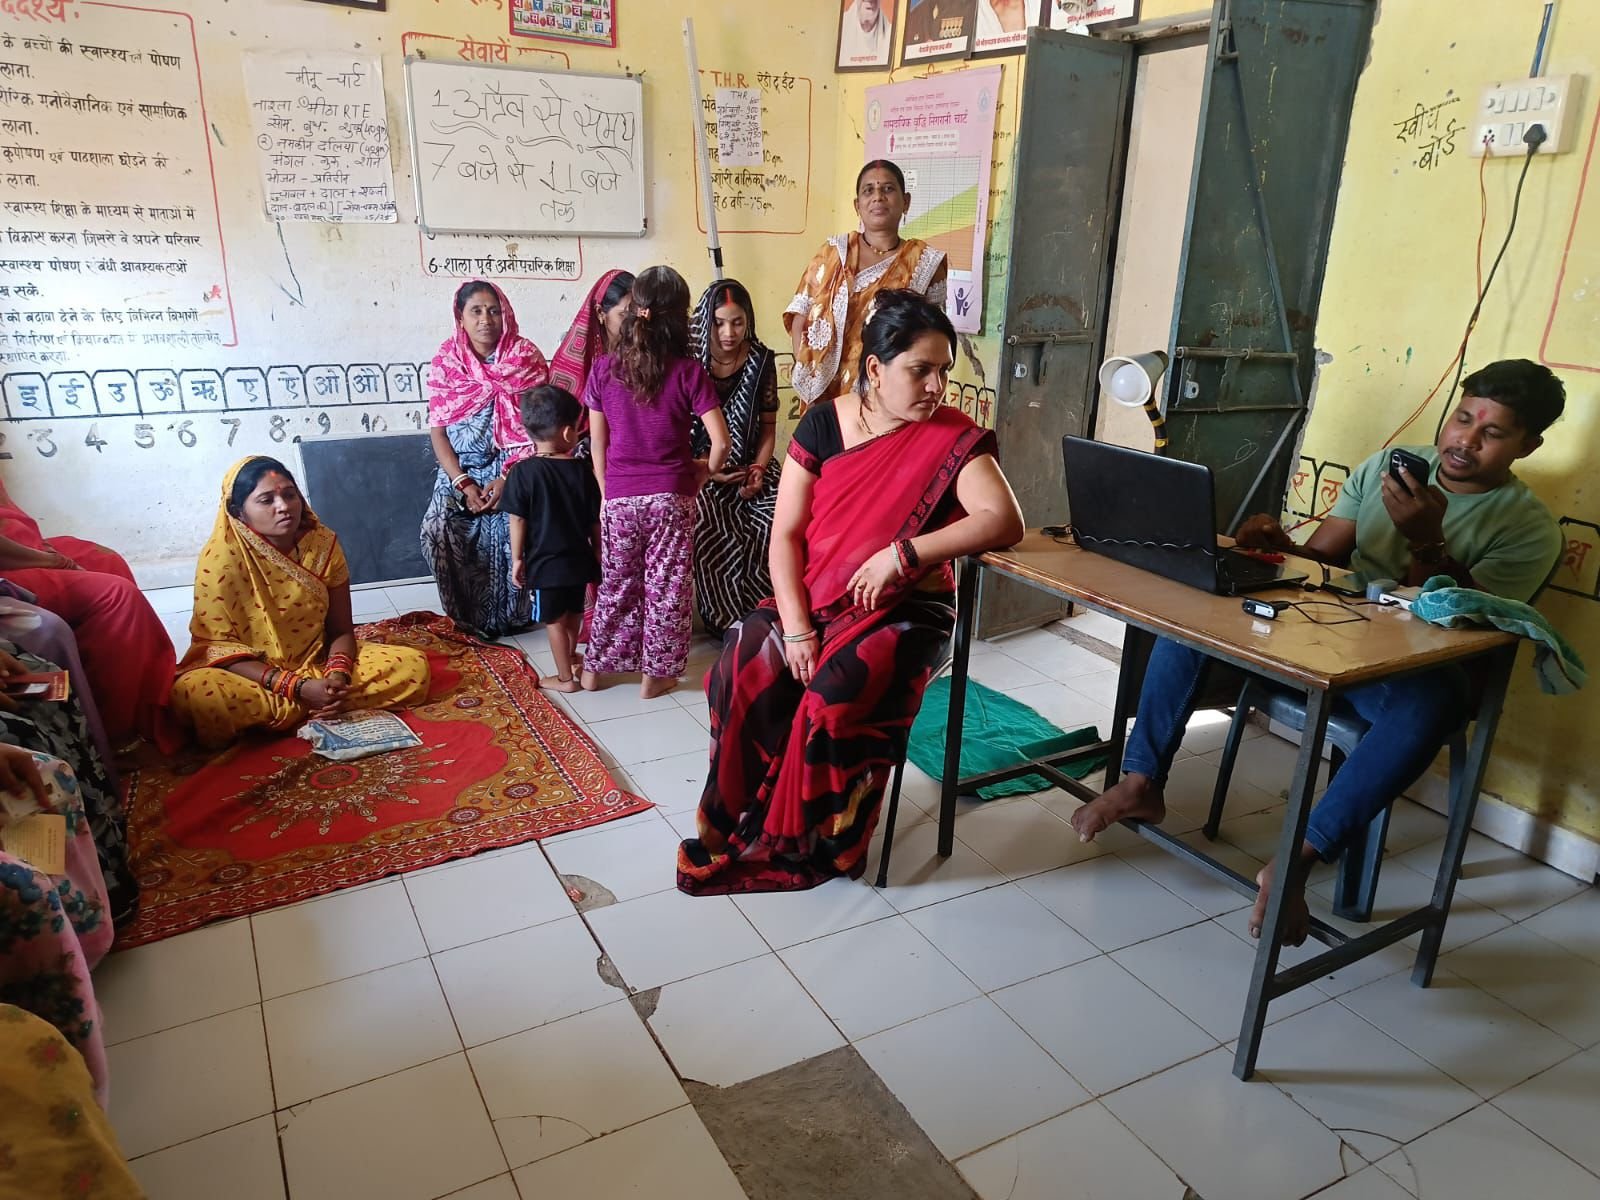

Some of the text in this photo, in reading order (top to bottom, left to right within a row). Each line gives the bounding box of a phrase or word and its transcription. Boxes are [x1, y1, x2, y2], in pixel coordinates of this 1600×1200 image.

[148, 49, 181, 70] पोषण
[456, 37, 511, 63] सेवायें
[423, 142, 455, 181] 7
[458, 145, 499, 184] बजे
[48, 231, 77, 248] करना
[132, 231, 160, 246] अपने
[164, 232, 203, 247] परिवार
[47, 256, 81, 273] पोषण
[18, 385, 41, 411] इ
[59, 378, 84, 409] ई
[108, 383, 127, 402] उ
[237, 378, 258, 402] ए
[278, 371, 300, 400] ऐ
[85, 422, 108, 453] 4
[135, 423, 155, 448] 5
[178, 419, 198, 448] 6
[220, 418, 242, 448] 7
[269, 415, 287, 443] 8
[317, 412, 331, 435] 9
[360, 412, 388, 433] 10
